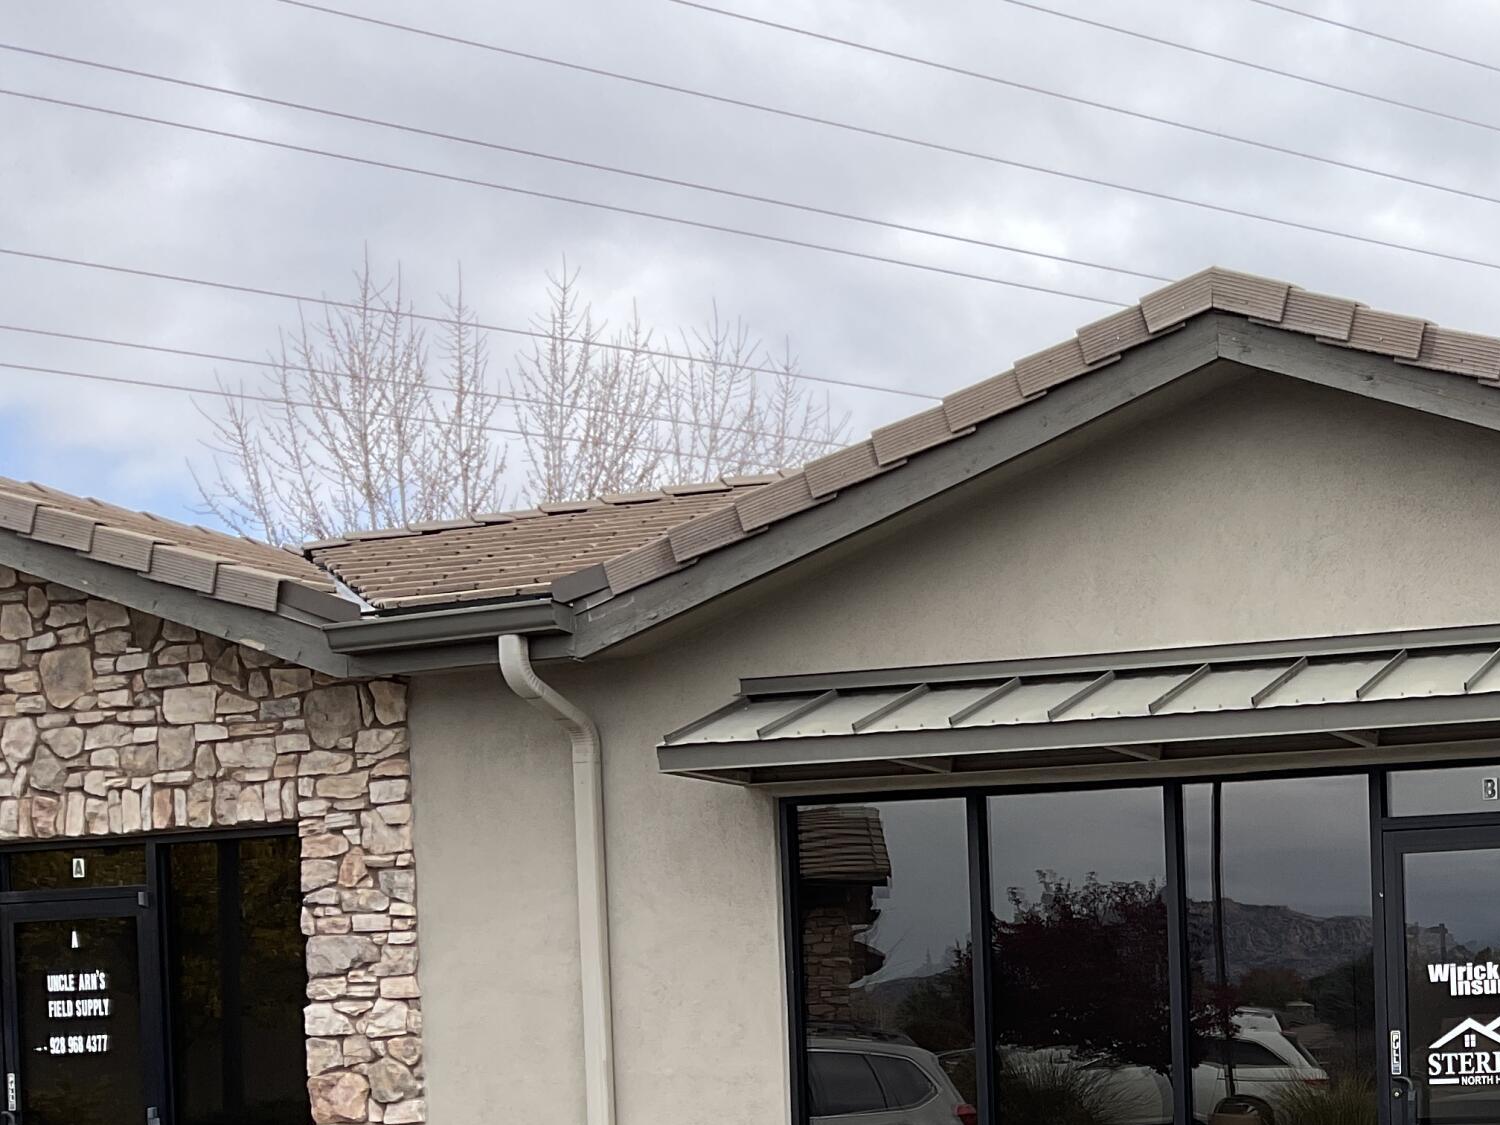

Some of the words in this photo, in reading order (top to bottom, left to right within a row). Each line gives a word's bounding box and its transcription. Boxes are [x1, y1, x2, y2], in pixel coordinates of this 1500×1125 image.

[1483, 779, 1496, 798] B
[71, 931, 79, 948] A
[1427, 962, 1500, 983] Wirick
[47, 973, 75, 992] UNCLE
[48, 1000, 73, 1018] FIELD
[76, 998, 110, 1017] SUPPLY
[50, 1036, 66, 1054] 928
[68, 1035, 84, 1053] 968
[86, 1034, 108, 1052] 4377
[1461, 1075, 1494, 1086] NORTH
